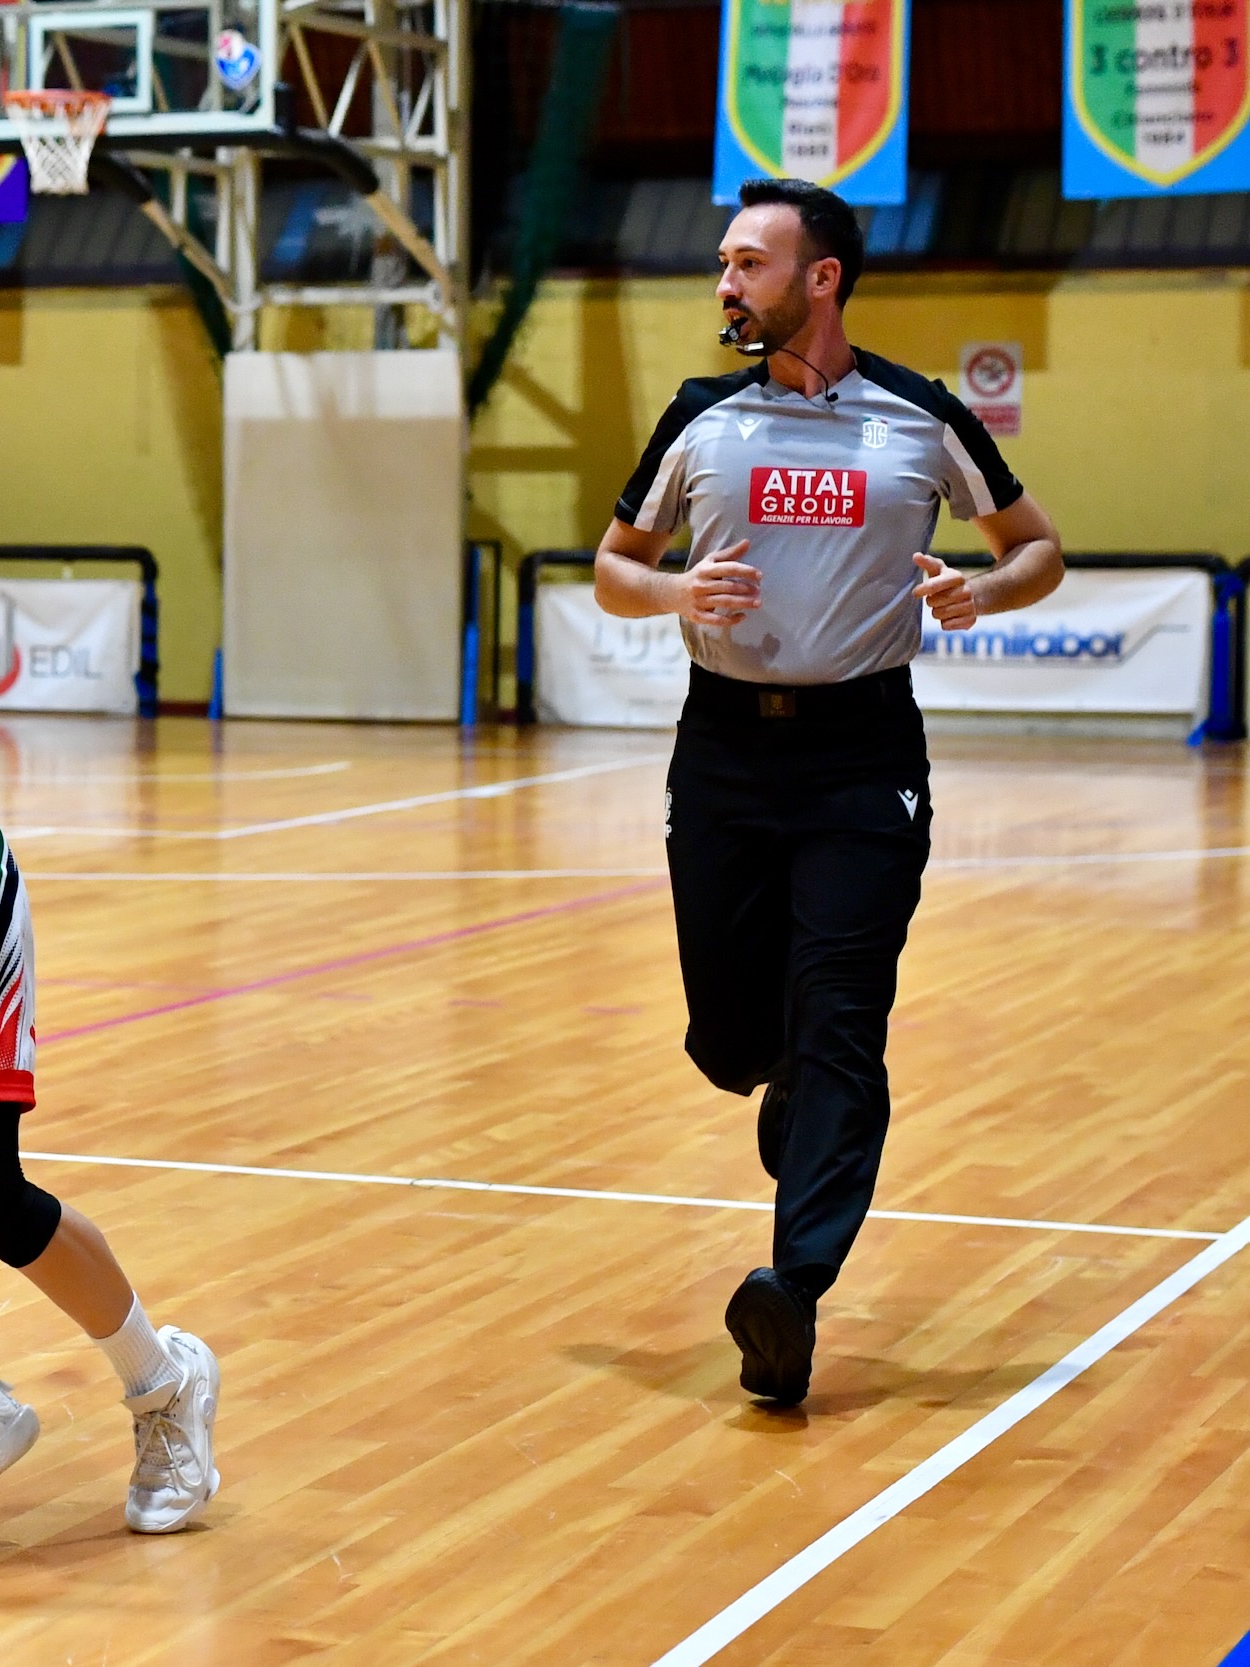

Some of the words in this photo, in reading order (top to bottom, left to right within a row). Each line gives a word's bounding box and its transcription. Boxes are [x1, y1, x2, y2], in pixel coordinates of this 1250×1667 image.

[762, 469, 855, 497] ATTAL
[760, 496, 854, 515] GROUP
[760, 514, 795, 523] AGENZIE
[795, 516, 811, 524] PER
[812, 516, 820, 524] IL
[820, 516, 853, 525] LAVORO
[29, 645, 103, 680] EDIL
